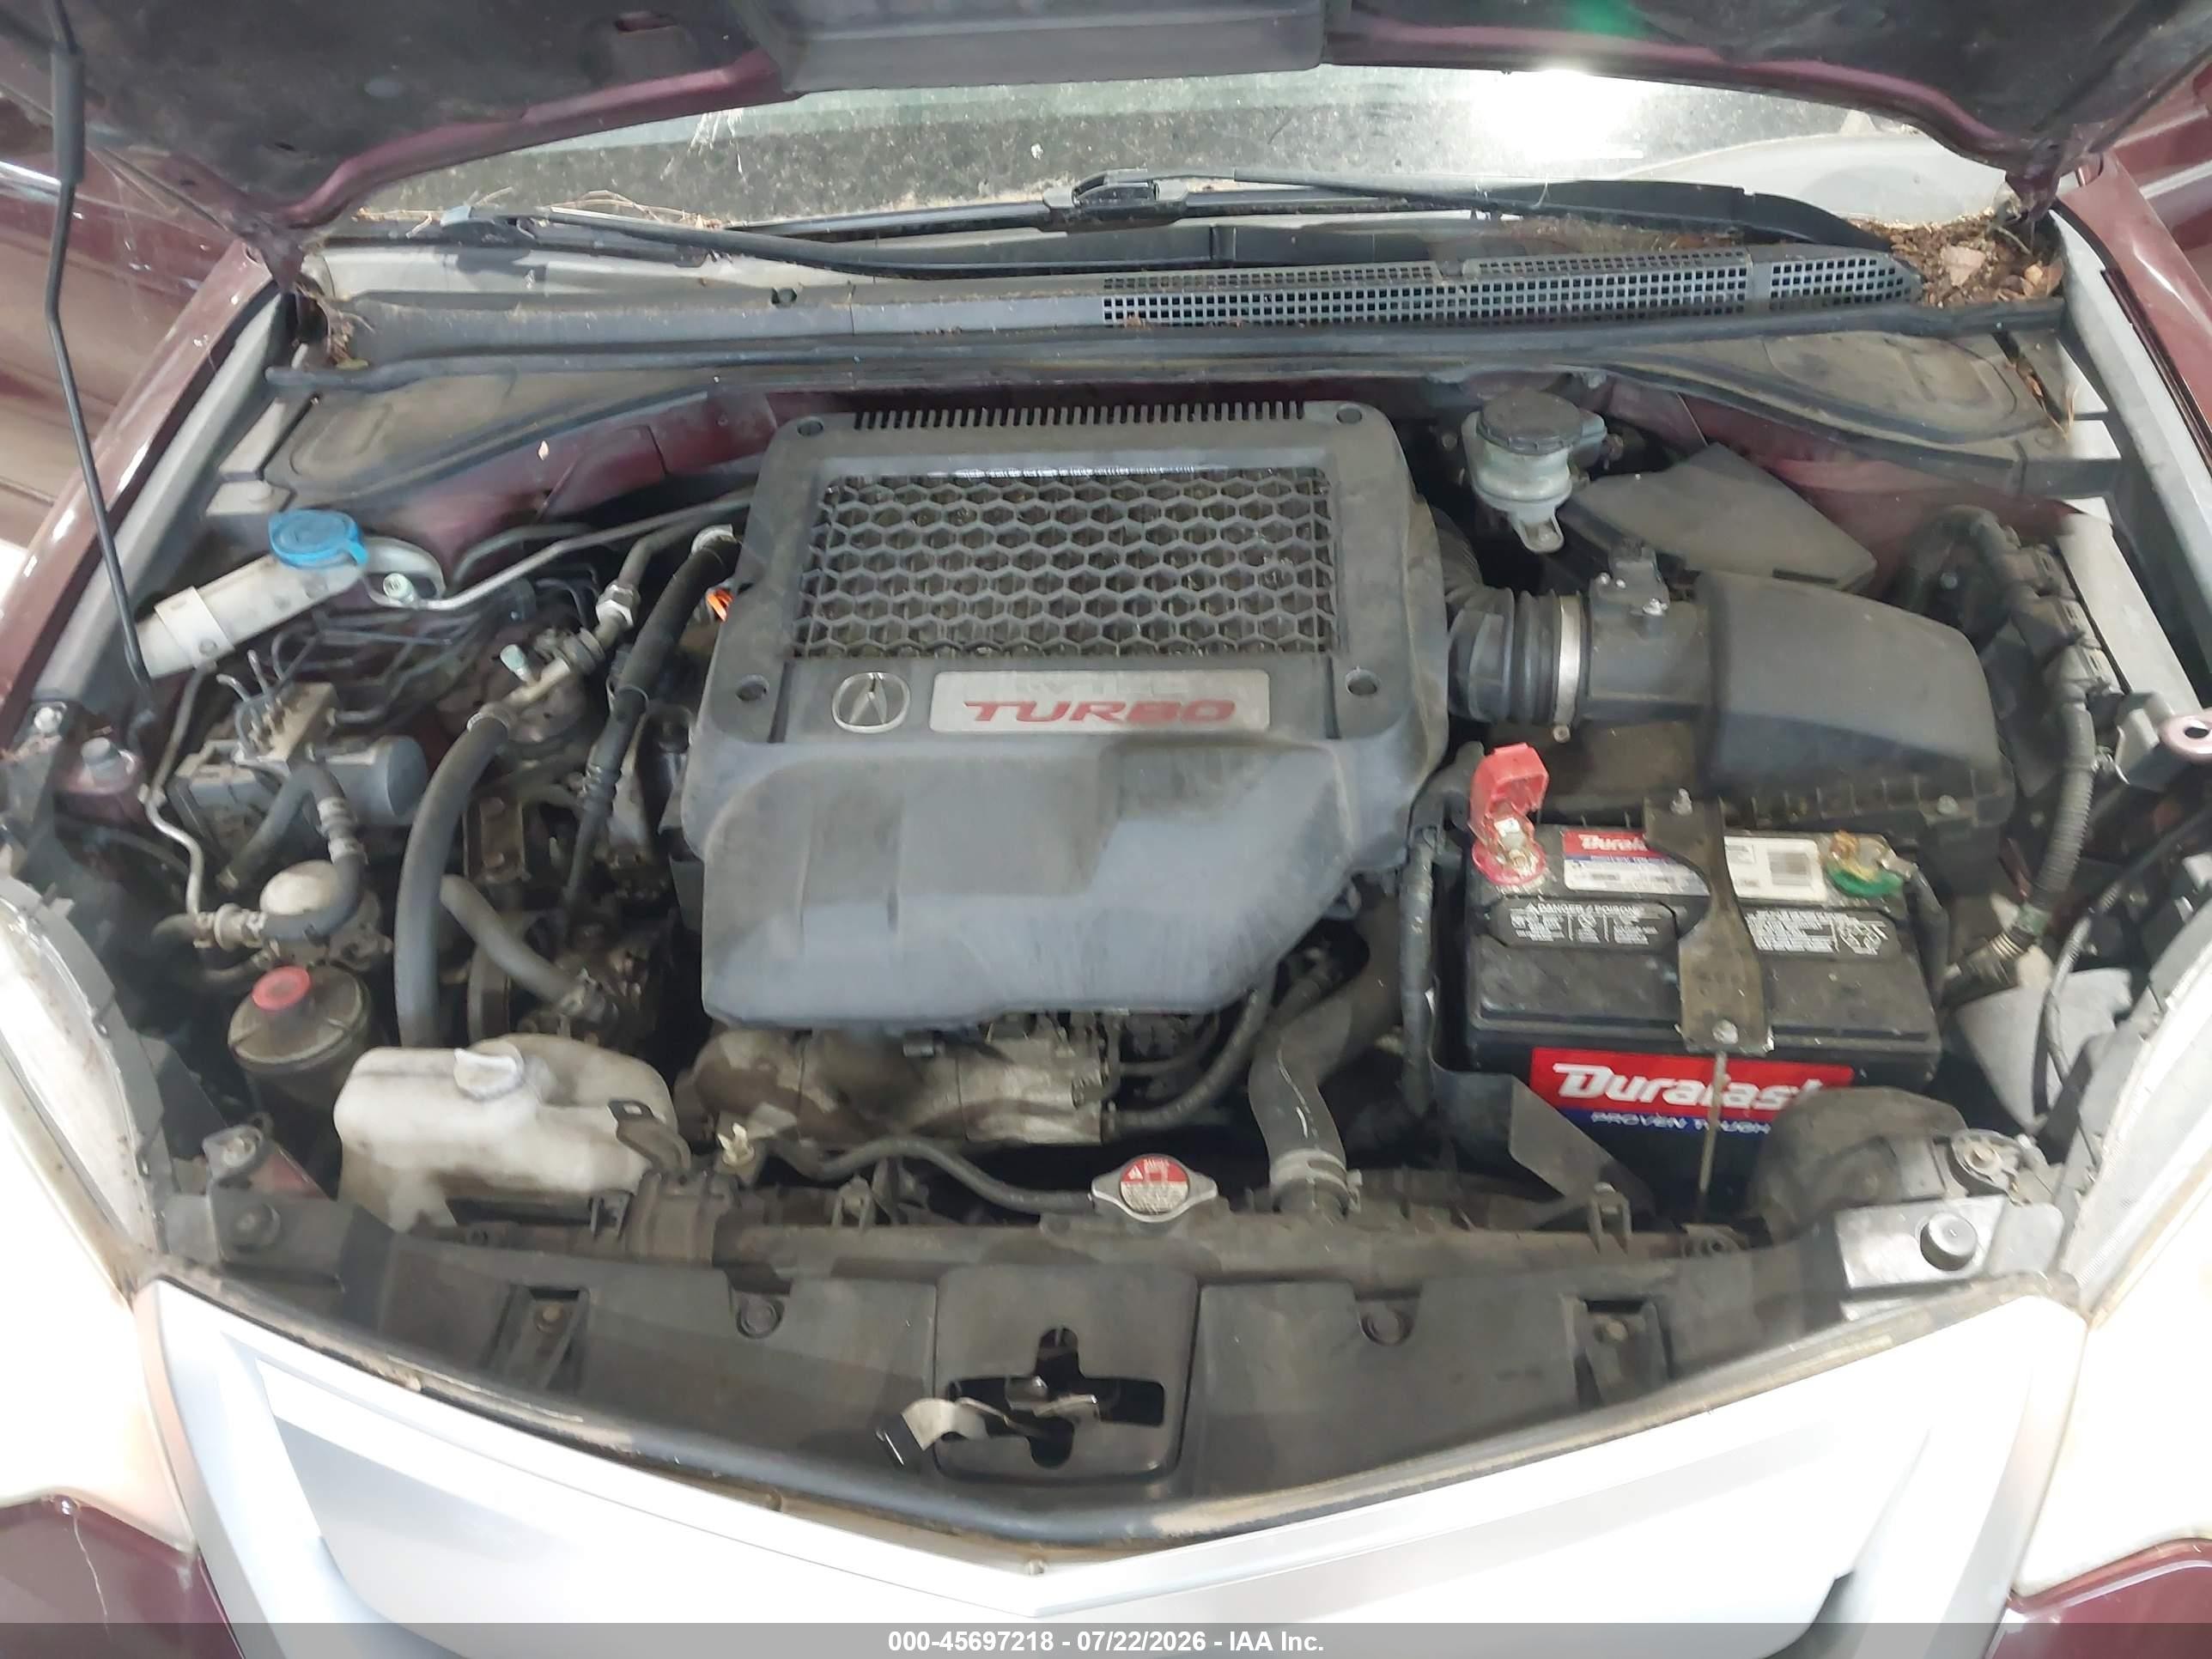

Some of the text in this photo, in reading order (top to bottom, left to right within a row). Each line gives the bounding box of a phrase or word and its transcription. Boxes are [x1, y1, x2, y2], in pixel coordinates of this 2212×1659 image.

[963, 700, 1236, 724] TURBO
[1578, 834, 1649, 852] Dural
[1590, 1111, 1771, 1134] PROVEN TUGH
